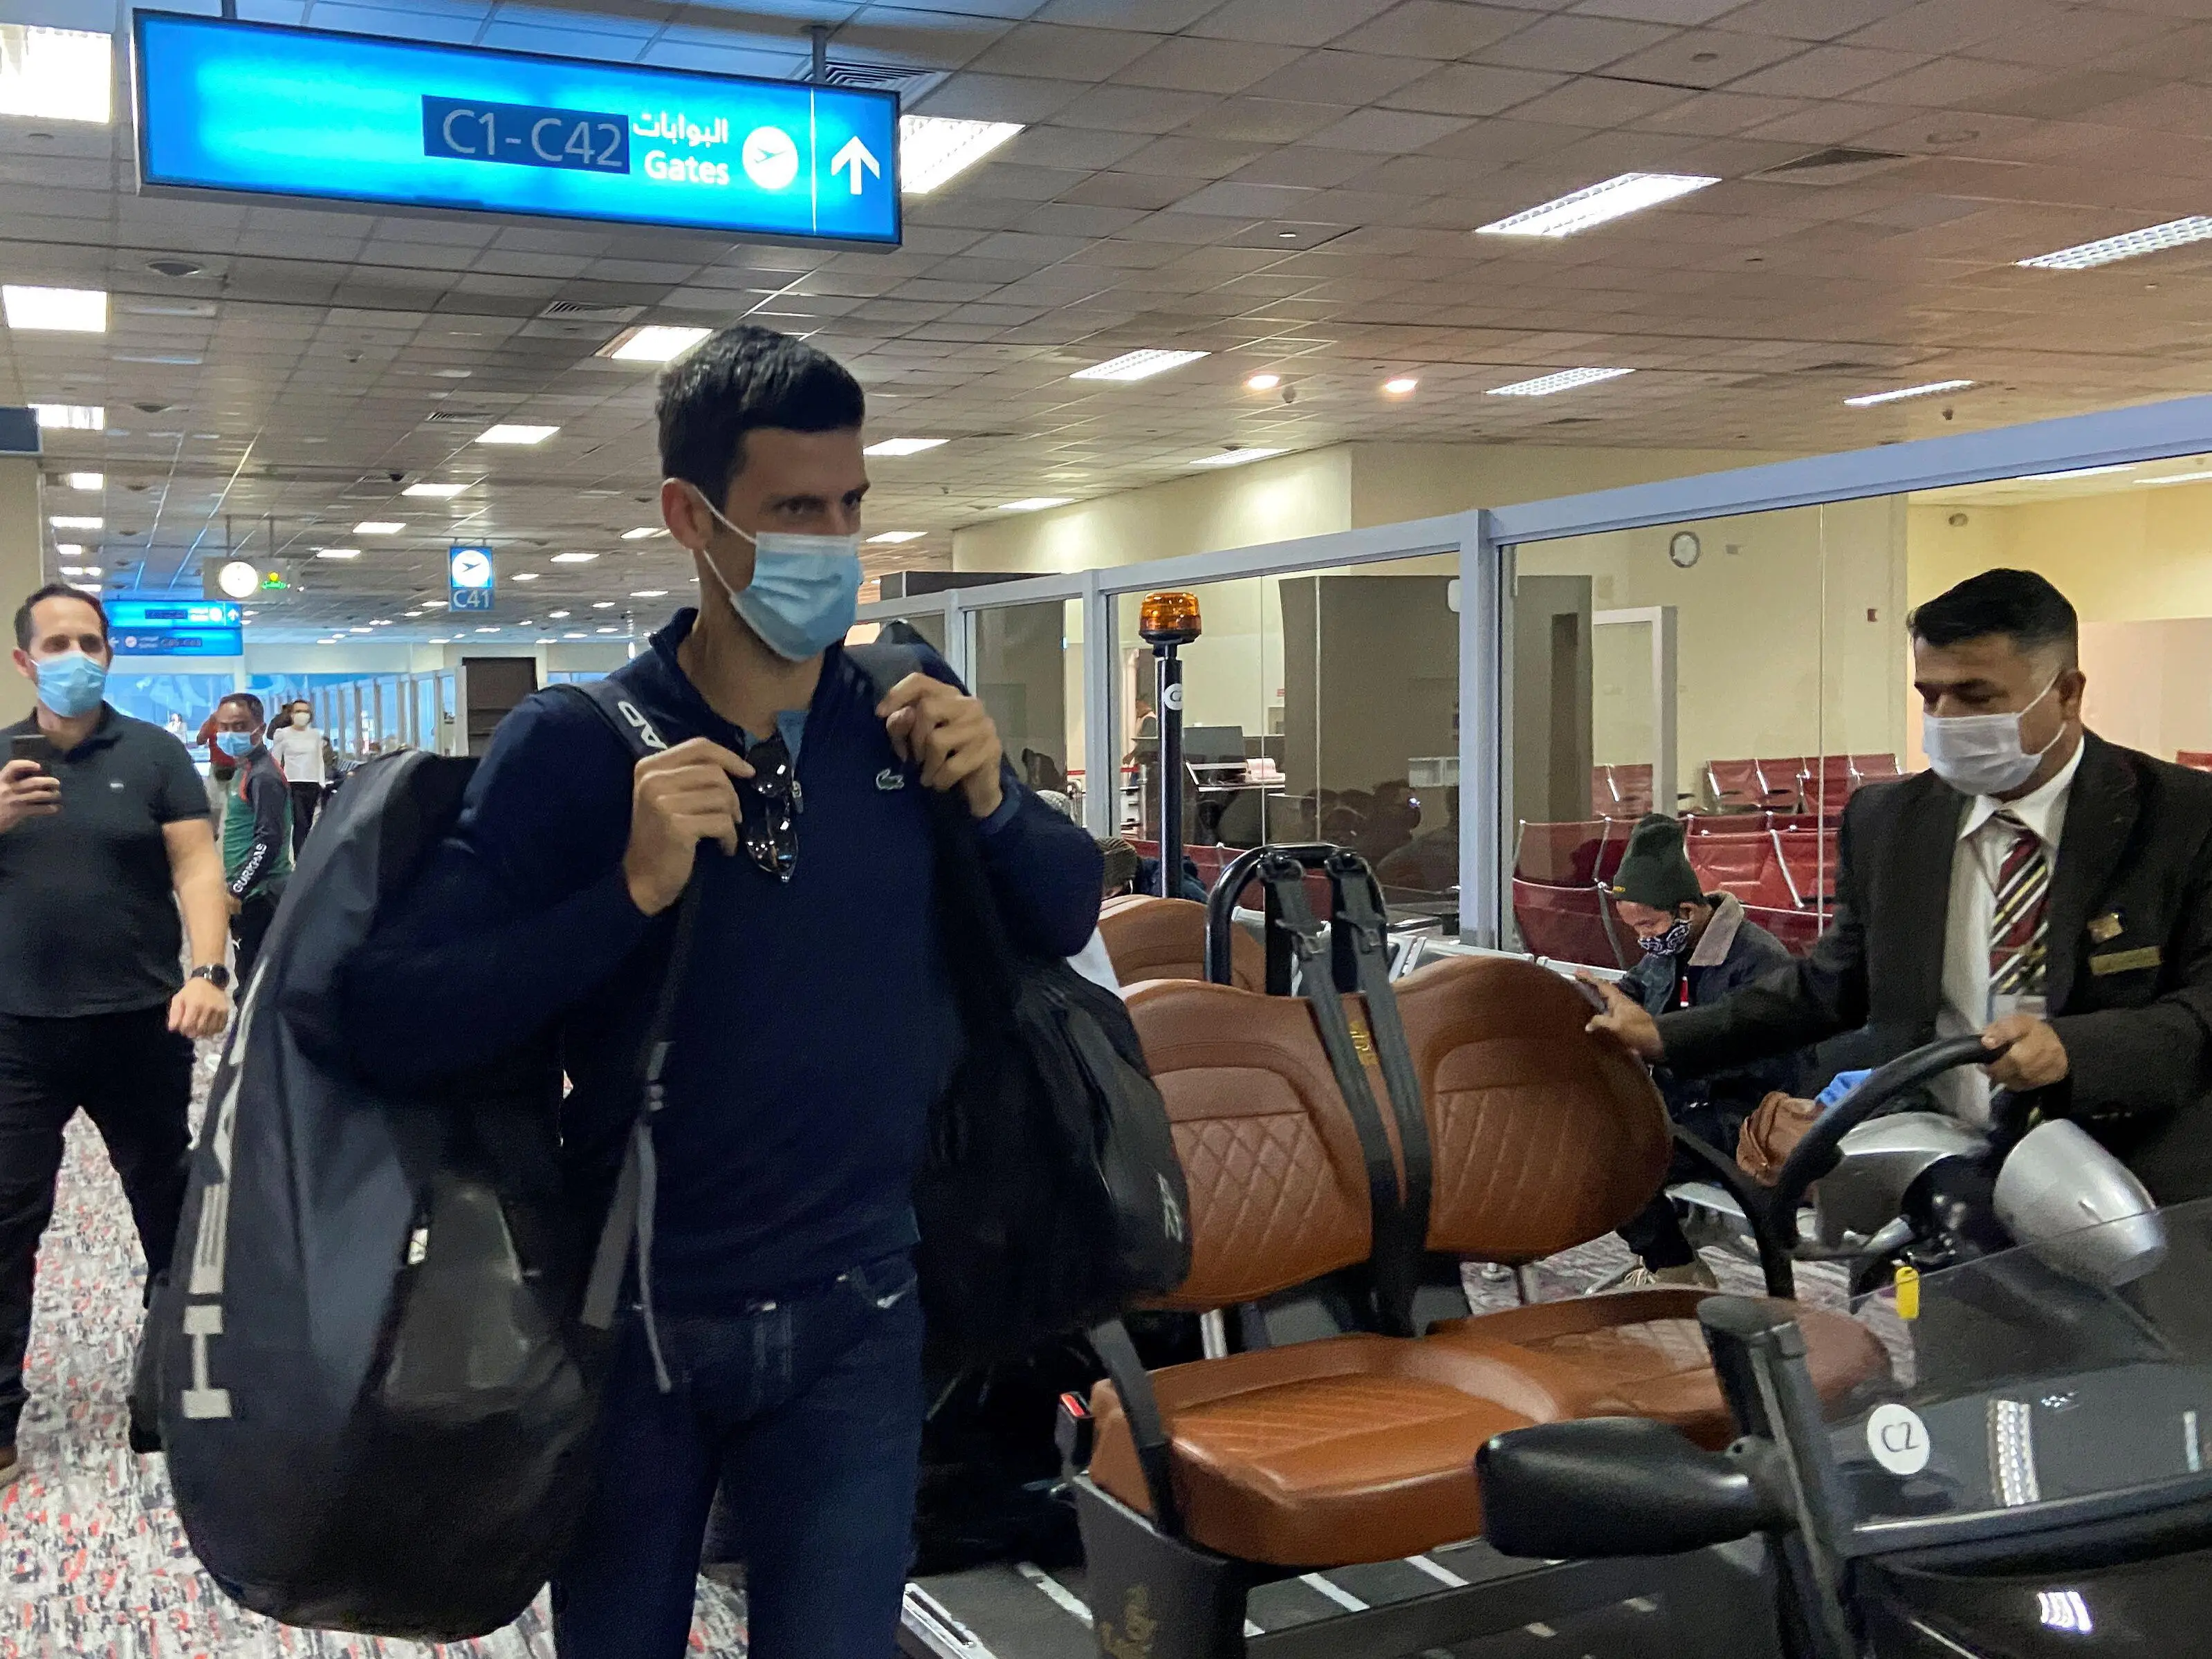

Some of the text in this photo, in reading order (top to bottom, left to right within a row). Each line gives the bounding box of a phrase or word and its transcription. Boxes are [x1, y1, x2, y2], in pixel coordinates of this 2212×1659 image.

[443, 109, 622, 167] C1-C42
[632, 111, 728, 148] البوابات
[644, 149, 730, 185] Gates
[453, 589, 490, 609] C41
